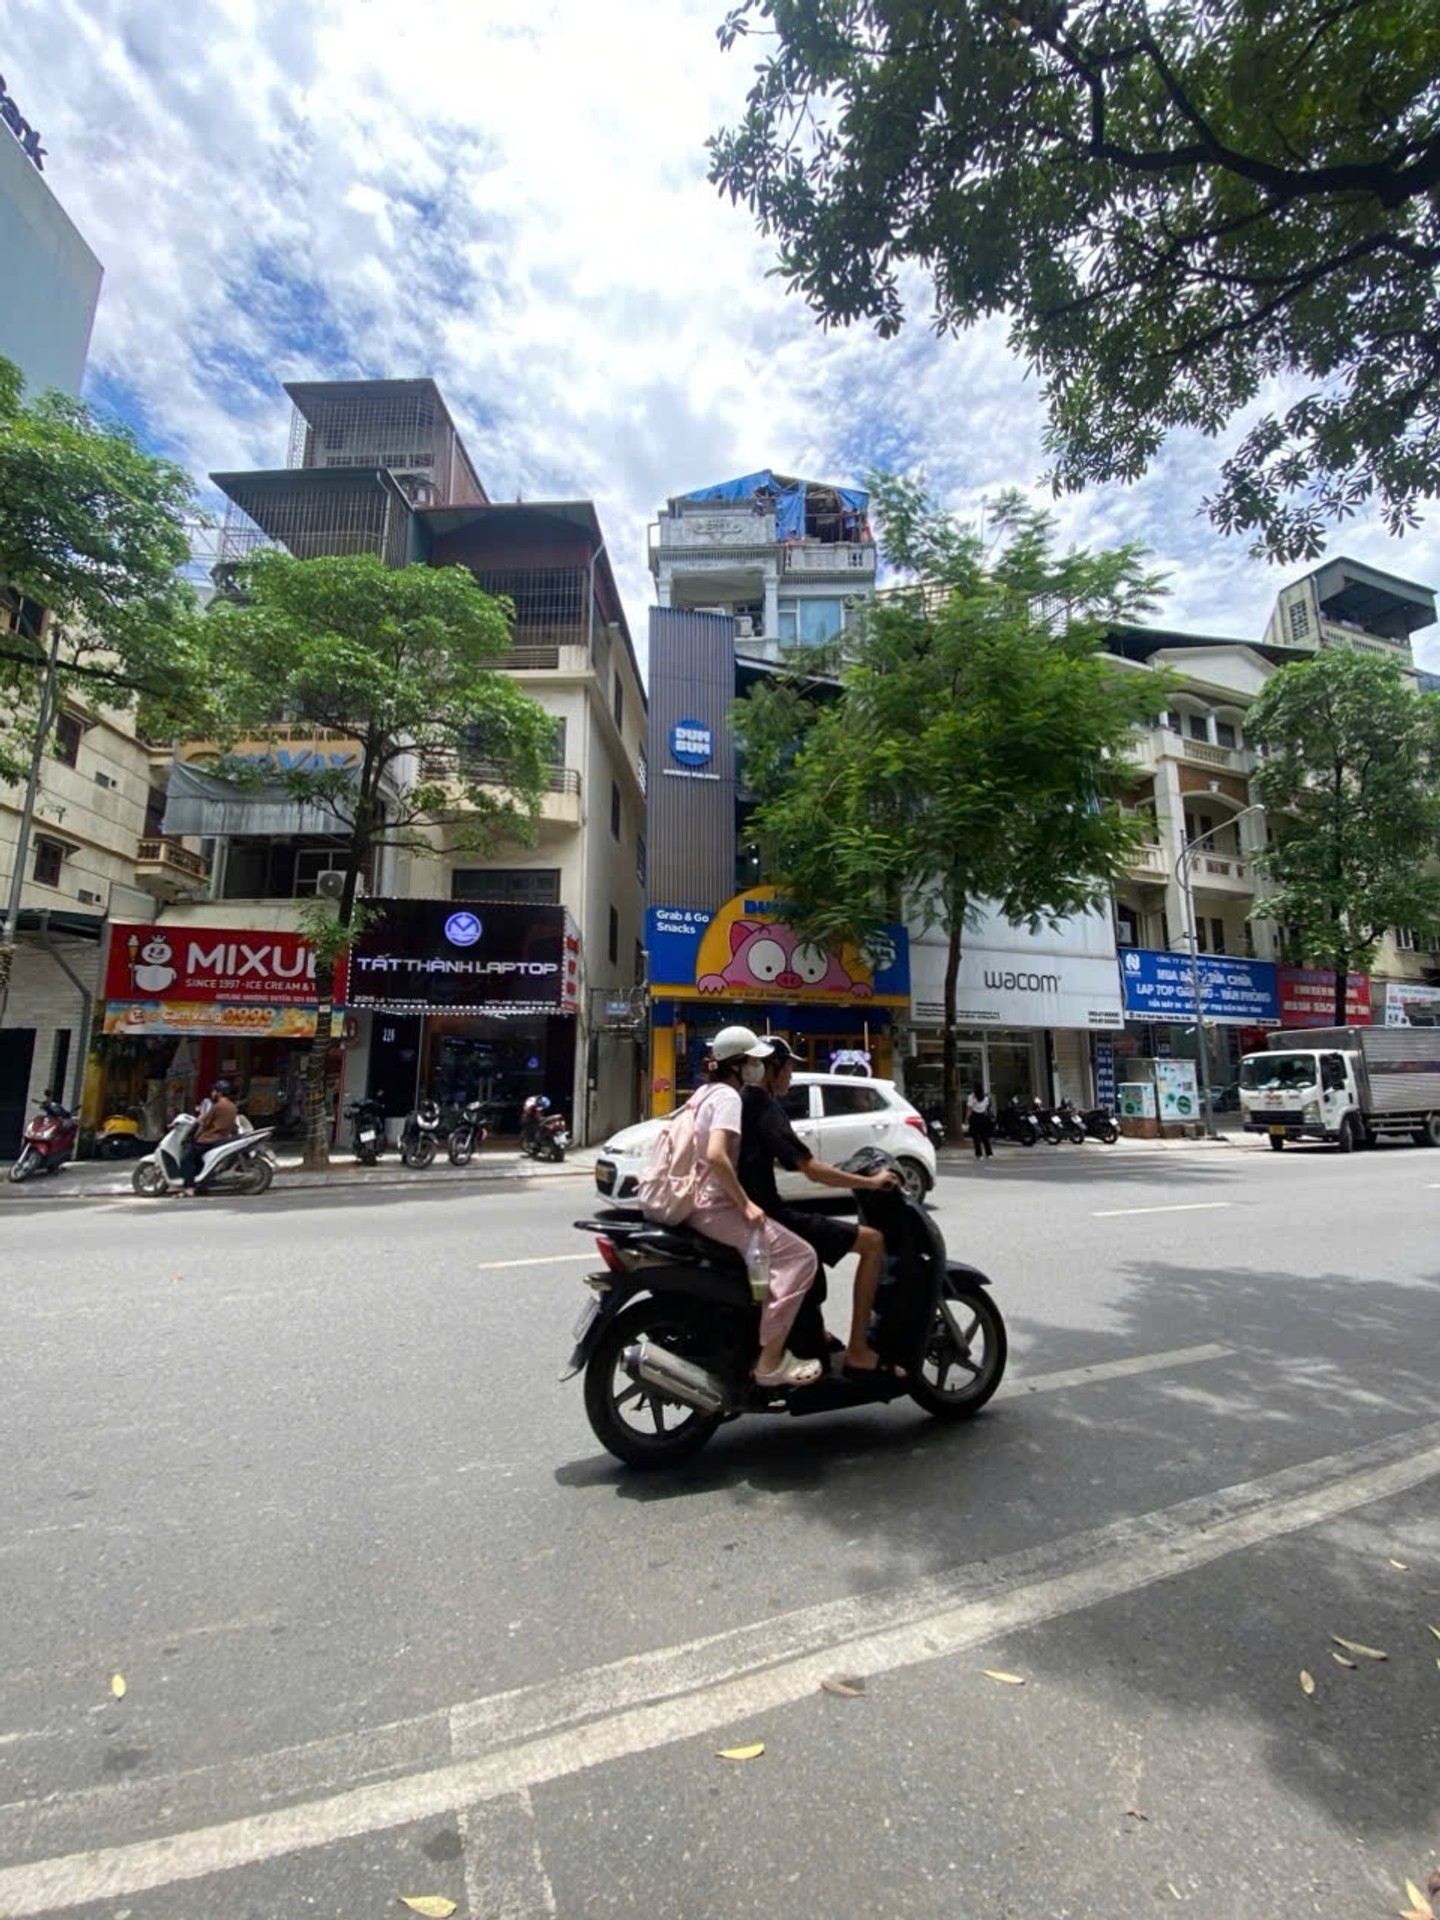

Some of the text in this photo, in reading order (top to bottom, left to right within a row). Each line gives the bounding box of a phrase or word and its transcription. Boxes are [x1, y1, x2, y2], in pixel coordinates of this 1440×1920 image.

[656, 909, 710, 924] Grab & Go
[656, 922, 696, 935] Snacks
[475, 960, 558, 975] LAPTOP
[185, 978, 217, 989] SINCE
[218, 979, 240, 990] 1997
[264, 981, 301, 992] CREAM
[984, 970, 1059, 993] wacom
[1155, 984, 1175, 997] TOP
